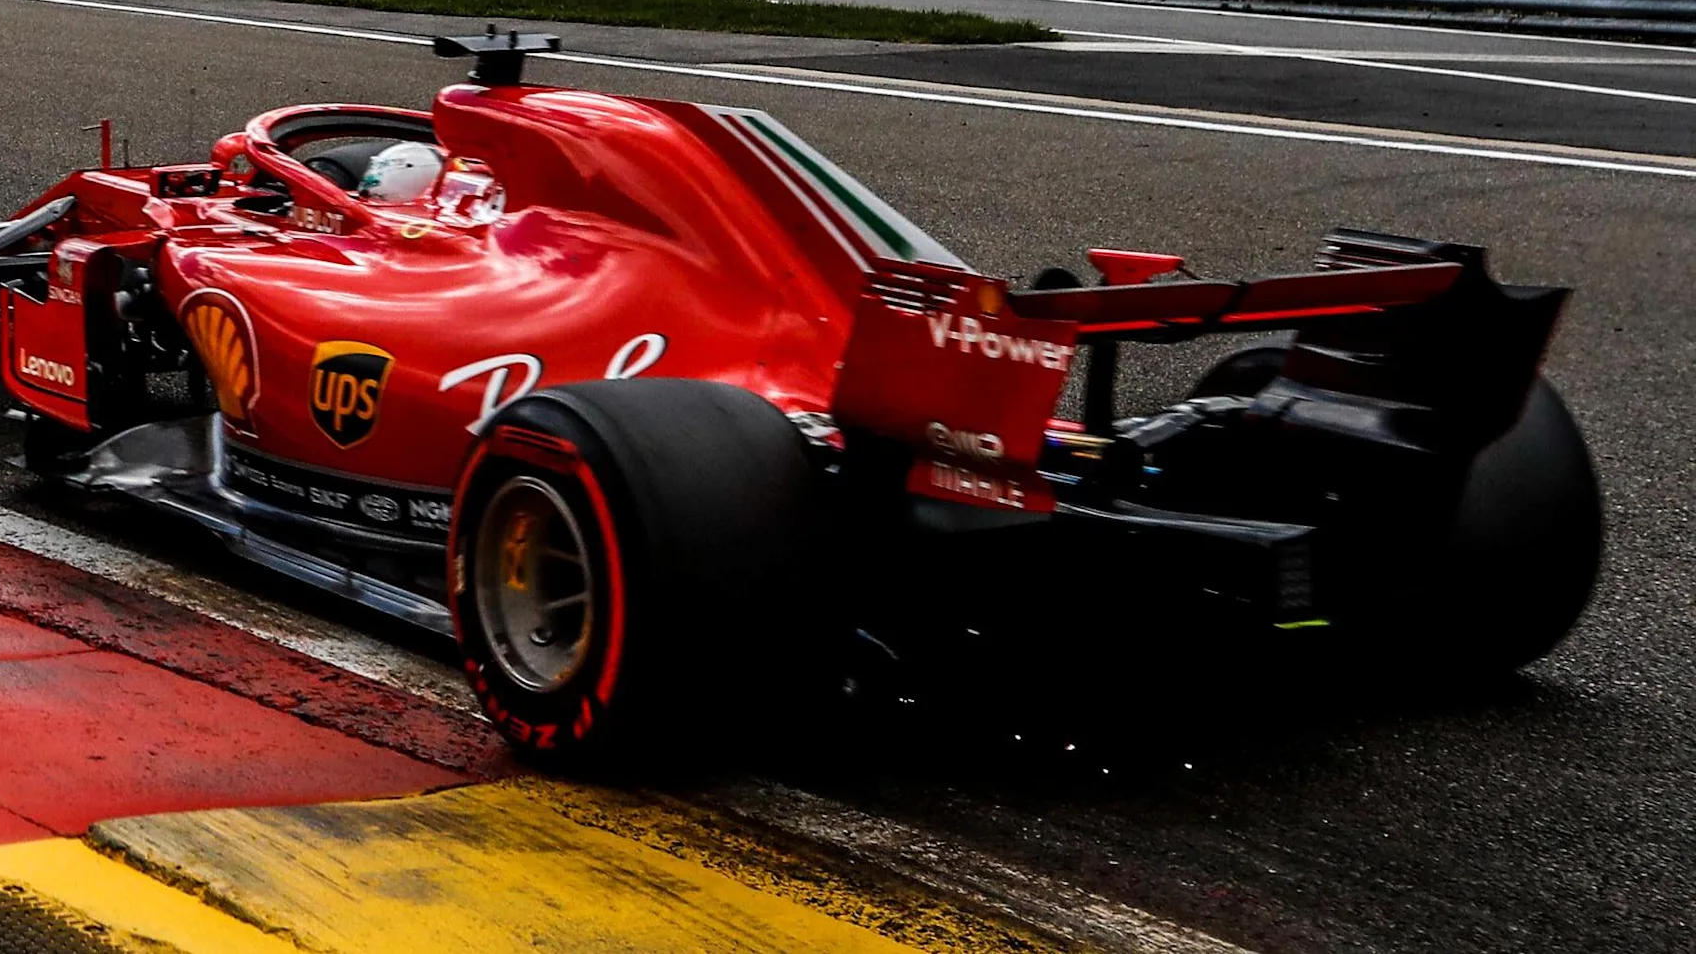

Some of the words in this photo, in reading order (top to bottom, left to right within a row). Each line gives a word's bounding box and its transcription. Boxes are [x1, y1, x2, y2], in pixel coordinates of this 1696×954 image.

[20, 347, 75, 386] Lenovo
[926, 312, 1075, 372] V-Power
[314, 368, 378, 432] ups
[308, 485, 352, 510] SKF
